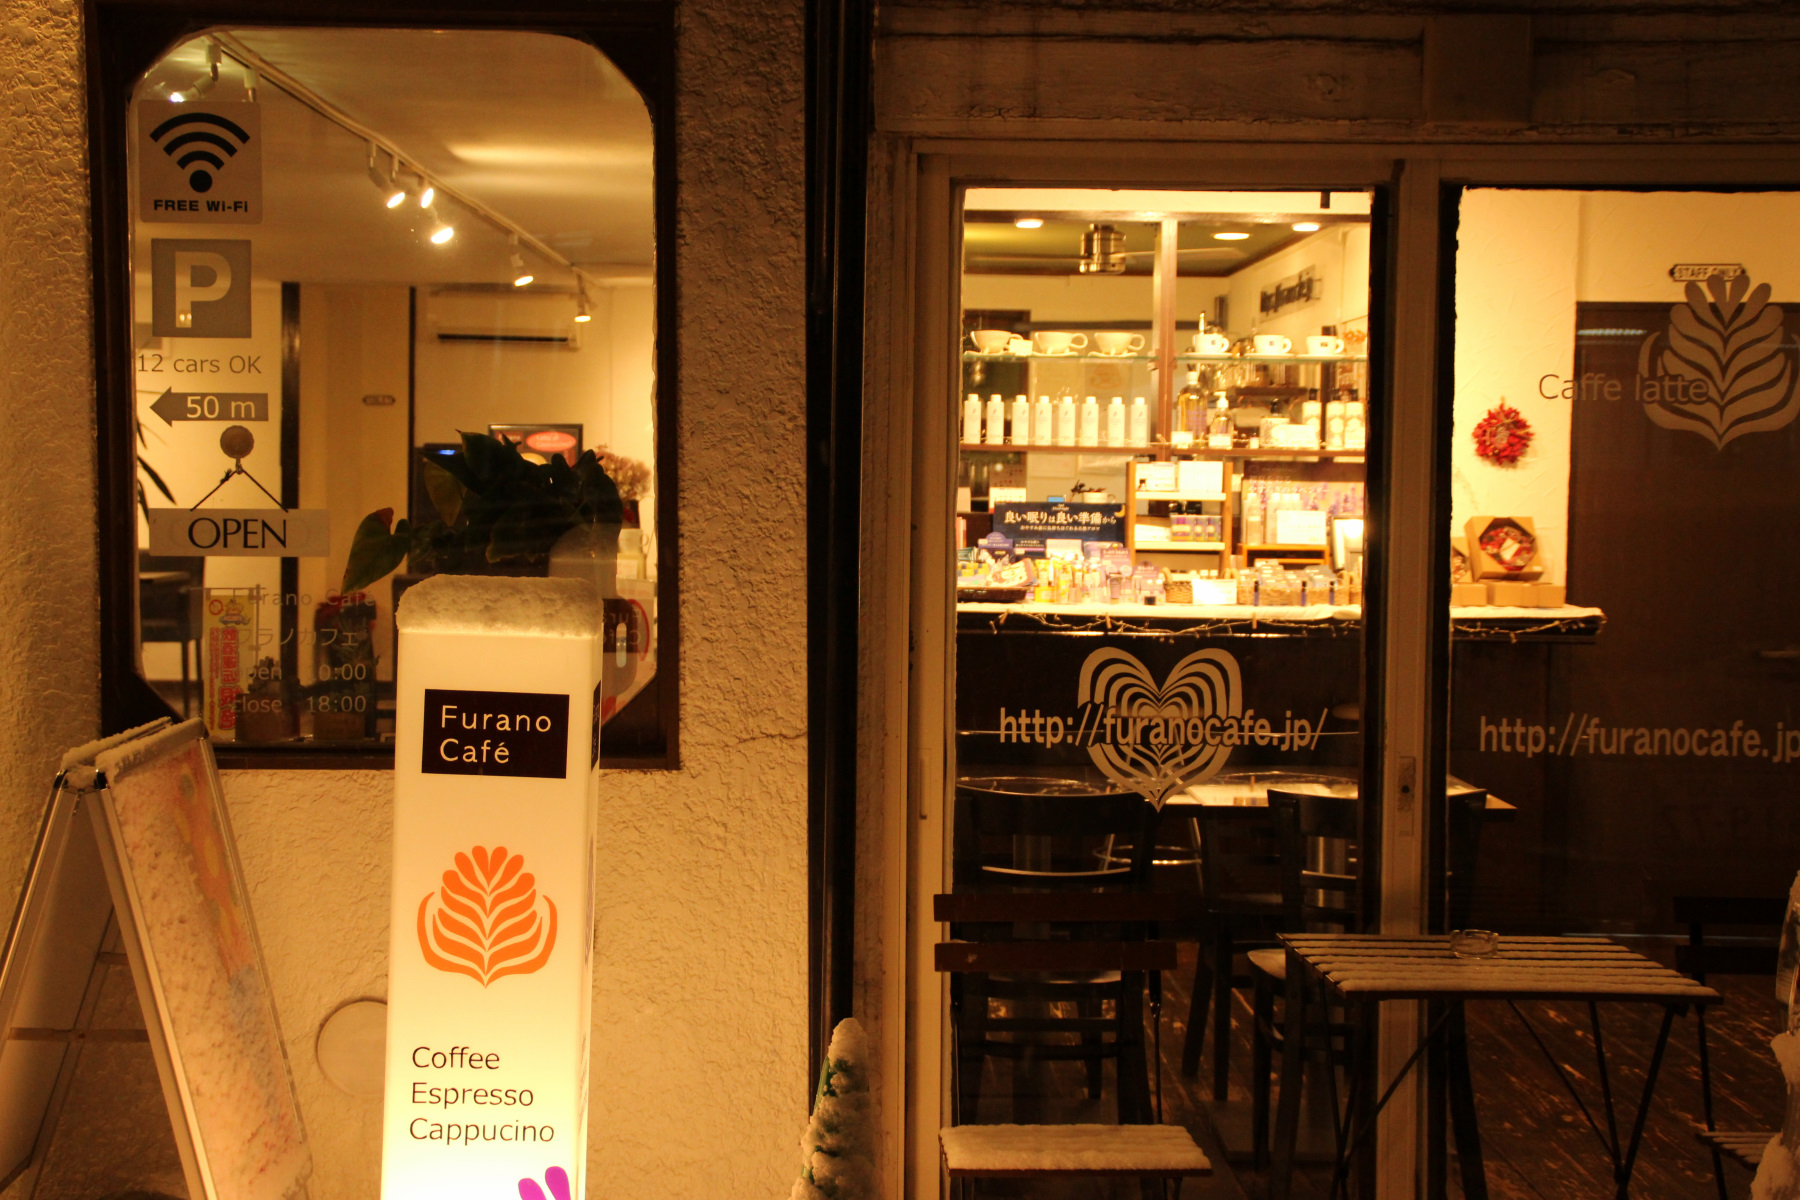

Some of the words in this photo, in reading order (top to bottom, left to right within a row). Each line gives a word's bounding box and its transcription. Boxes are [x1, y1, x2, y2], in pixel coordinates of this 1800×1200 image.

[153, 199, 200, 212] FREE
[206, 200, 248, 213] Wi-Fi
[175, 251, 232, 328] P
[137, 353, 164, 373] 12
[173, 358, 221, 373] cars
[229, 354, 262, 374] OK
[1538, 371, 1623, 402] Caffe
[1635, 373, 1710, 402] latte
[186, 395, 220, 419] 50
[230, 400, 256, 419] m
[1003, 510, 1117, 525] 良い眠りは良い準備から
[187, 517, 287, 549] OPEN
[308, 663, 367, 682] 0:00
[231, 696, 283, 714] close
[306, 695, 367, 714] 18:00
[441, 704, 552, 733] Furano
[999, 702, 1328, 751] http://furanocafe.jp/
[439, 737, 510, 764] Café
[411, 1045, 501, 1070] Coffee
[411, 1081, 534, 1110] Espresso
[409, 1117, 555, 1147] Cappucino
